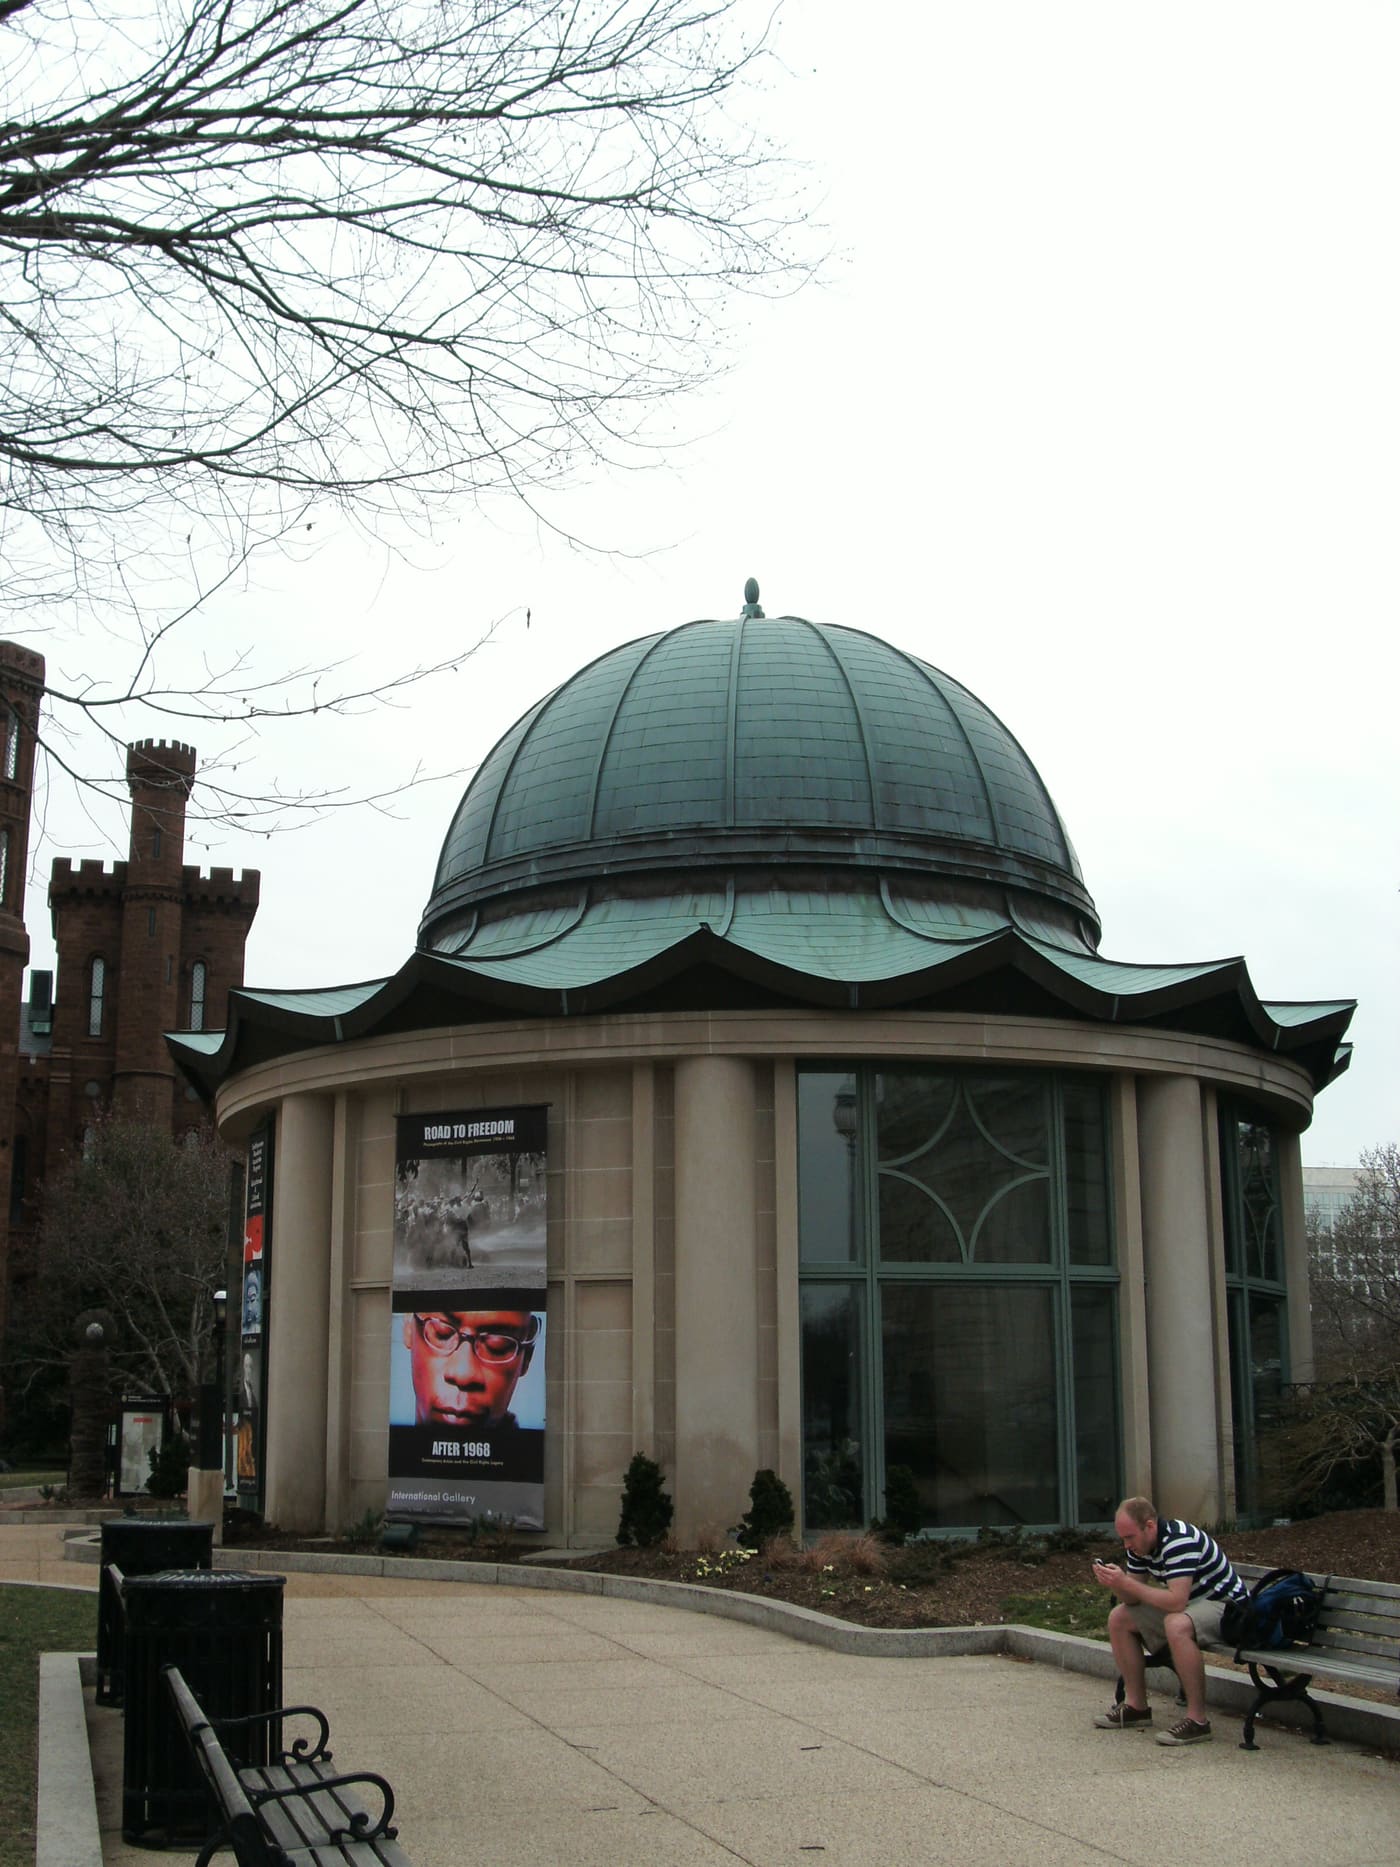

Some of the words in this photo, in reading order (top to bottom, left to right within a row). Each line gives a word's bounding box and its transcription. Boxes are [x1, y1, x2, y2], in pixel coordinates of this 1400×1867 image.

[424, 1126, 451, 1140] ROAD
[453, 1124, 466, 1138] TO
[468, 1120, 514, 1137] FREEDOM
[432, 1441, 460, 1456] AFTER
[462, 1442, 490, 1457] 1968
[391, 1490, 441, 1501] International
[442, 1492, 476, 1504] Gallery
